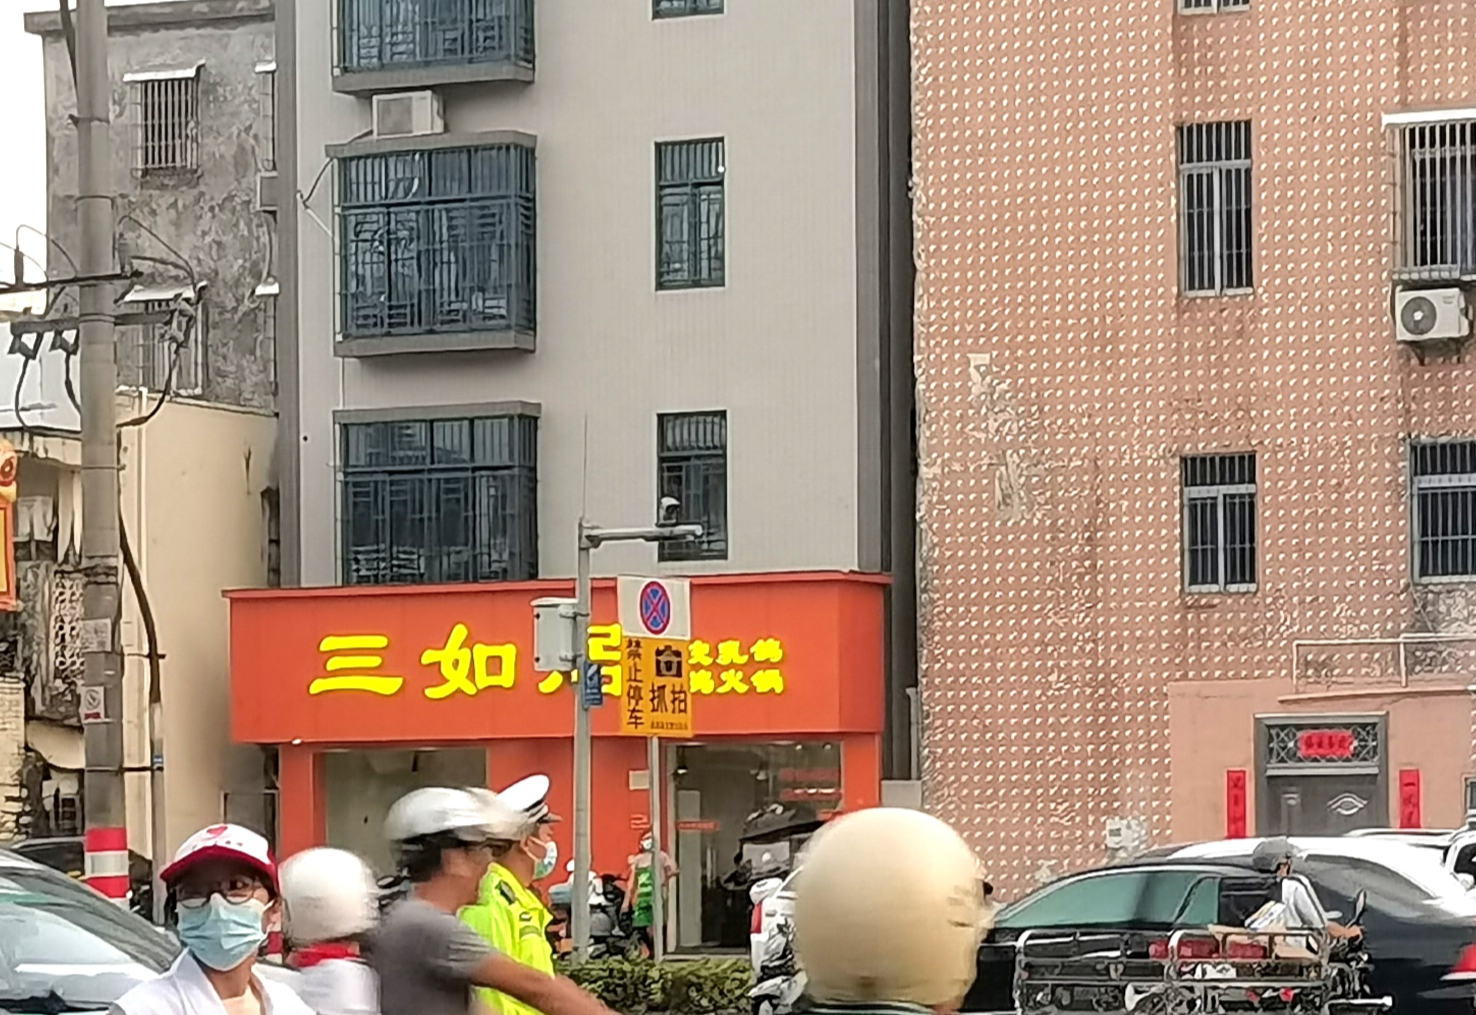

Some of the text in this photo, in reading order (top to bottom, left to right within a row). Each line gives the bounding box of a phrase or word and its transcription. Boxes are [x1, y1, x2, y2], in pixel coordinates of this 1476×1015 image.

[626, 638, 645, 730] 禁止停车
[649, 681, 688, 715] 抓拍
